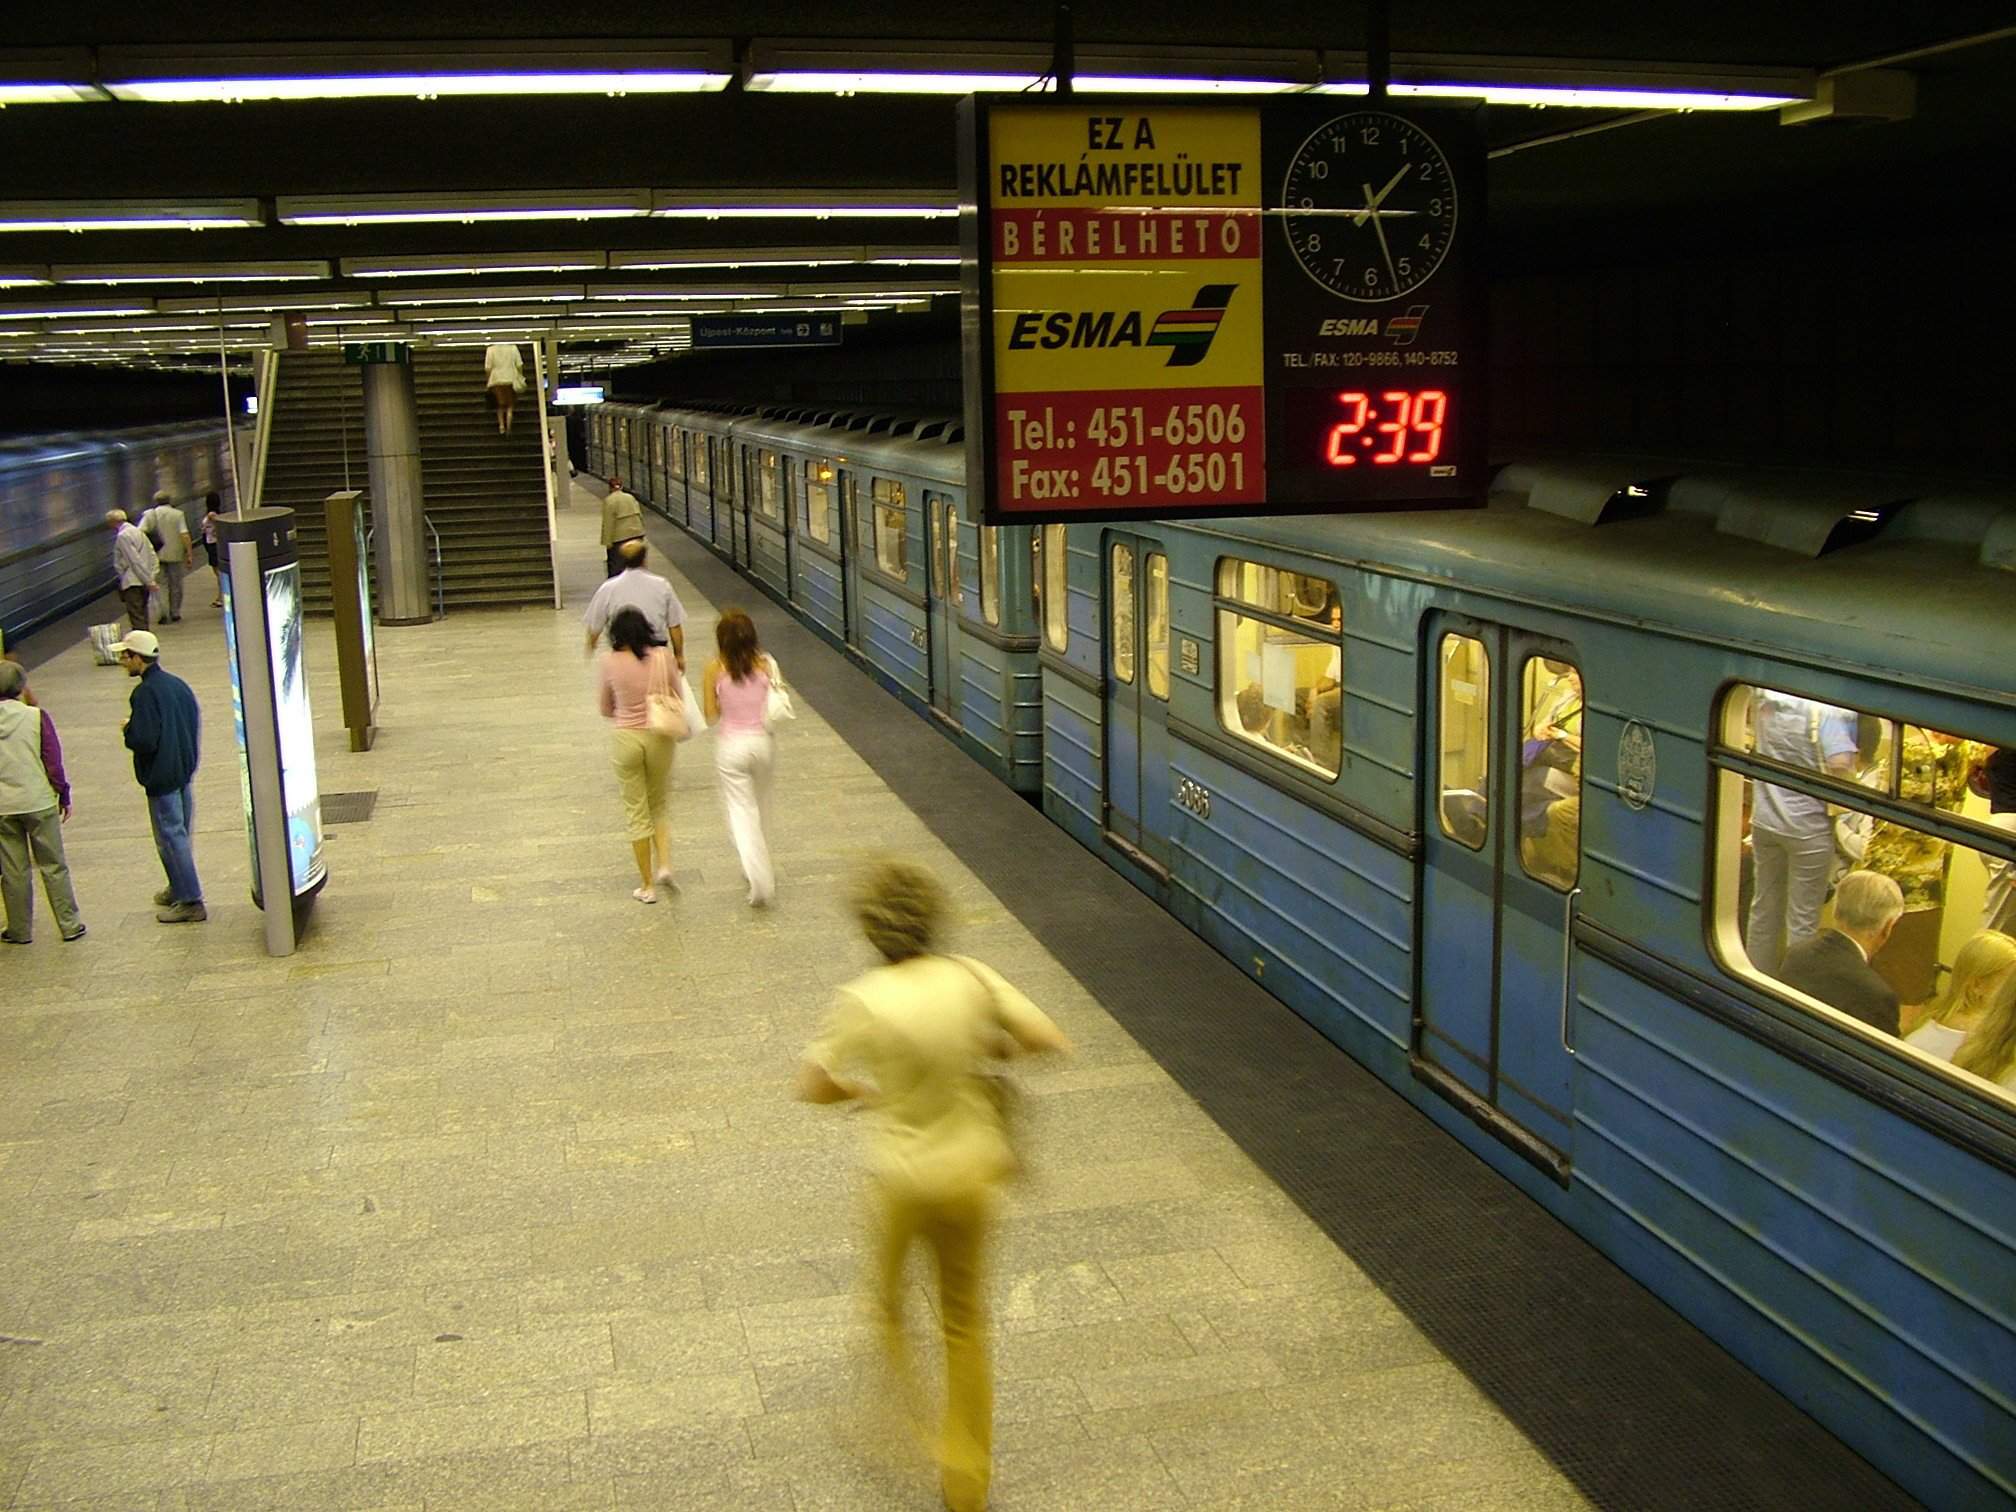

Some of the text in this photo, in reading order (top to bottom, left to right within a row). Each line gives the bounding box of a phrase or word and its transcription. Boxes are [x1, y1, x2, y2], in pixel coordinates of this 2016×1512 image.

[1088, 117, 1155, 150] EZ A
[1360, 127, 1380, 145] 12
[1332, 136, 1346, 153] 11
[1400, 138, 1408, 155] 1
[1000, 153, 1242, 197] REKLÁMFELÜLET
[1308, 160, 1328, 179] 10
[1419, 162, 1433, 181] 2
[1300, 197, 1314, 216] 9
[1429, 198, 1442, 216] 3
[1003, 210, 1241, 256] BÉRELHETŐ
[1307, 233, 1321, 252] 8
[1418, 233, 1431, 249] 4
[1333, 258, 1345, 276] 7
[1399, 257, 1411, 275] 5
[1364, 267, 1378, 286] 6
[1008, 311, 1142, 350] ESMA
[1319, 319, 1379, 336] ESMA
[1008, 404, 1246, 450] Tel.: 451-6506
[1327, 391, 1447, 465] 2:39
[1012, 452, 1244, 499] Fax: 451-6501
